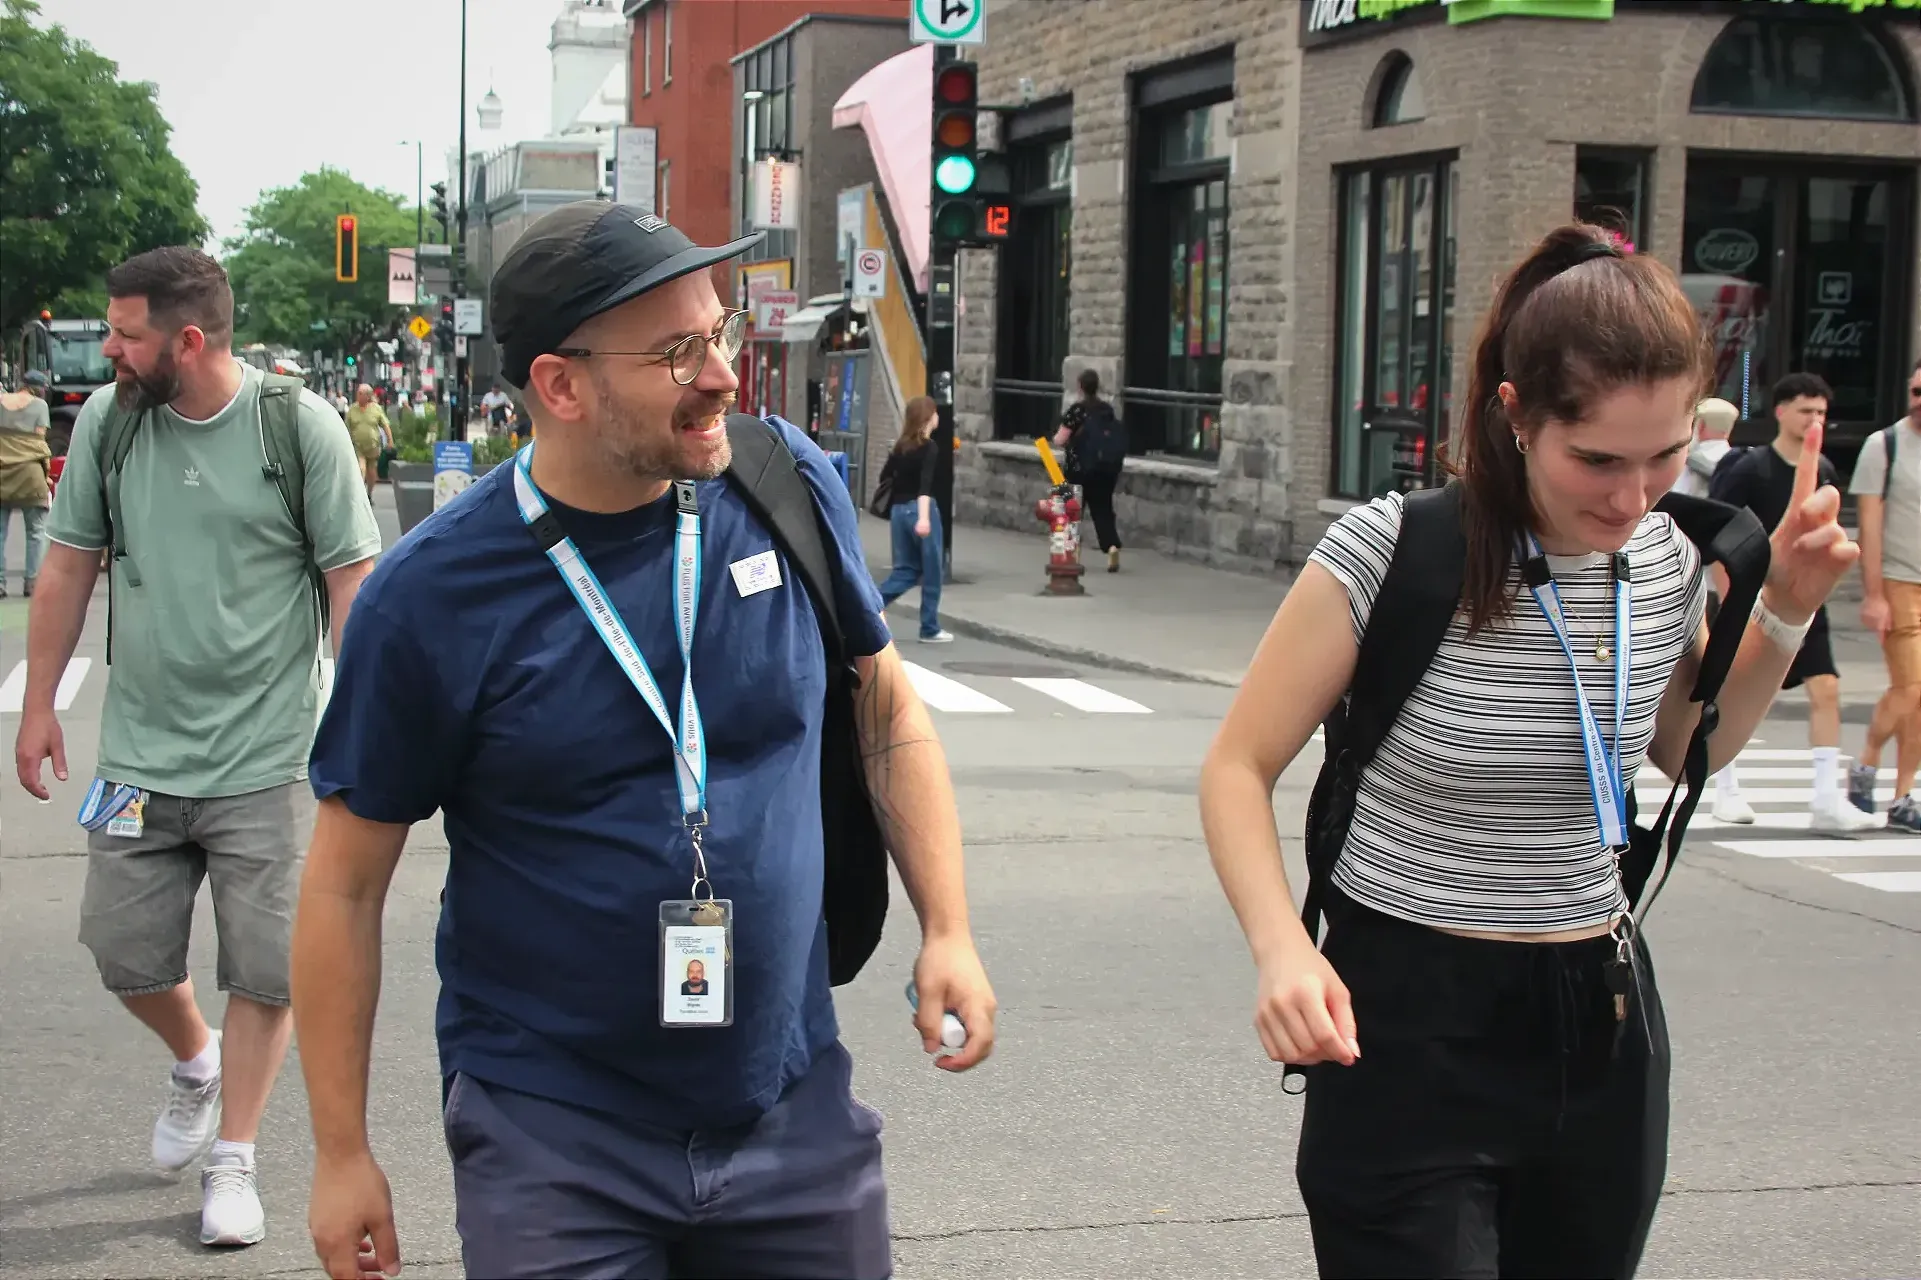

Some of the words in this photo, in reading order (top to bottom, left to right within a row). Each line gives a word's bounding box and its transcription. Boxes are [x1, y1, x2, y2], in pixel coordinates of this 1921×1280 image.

[986, 206, 1010, 236] 12
[687, 719, 696, 739] VOUS
[1597, 762, 1606, 774] du
[1598, 775, 1611, 804] CIUSSS
